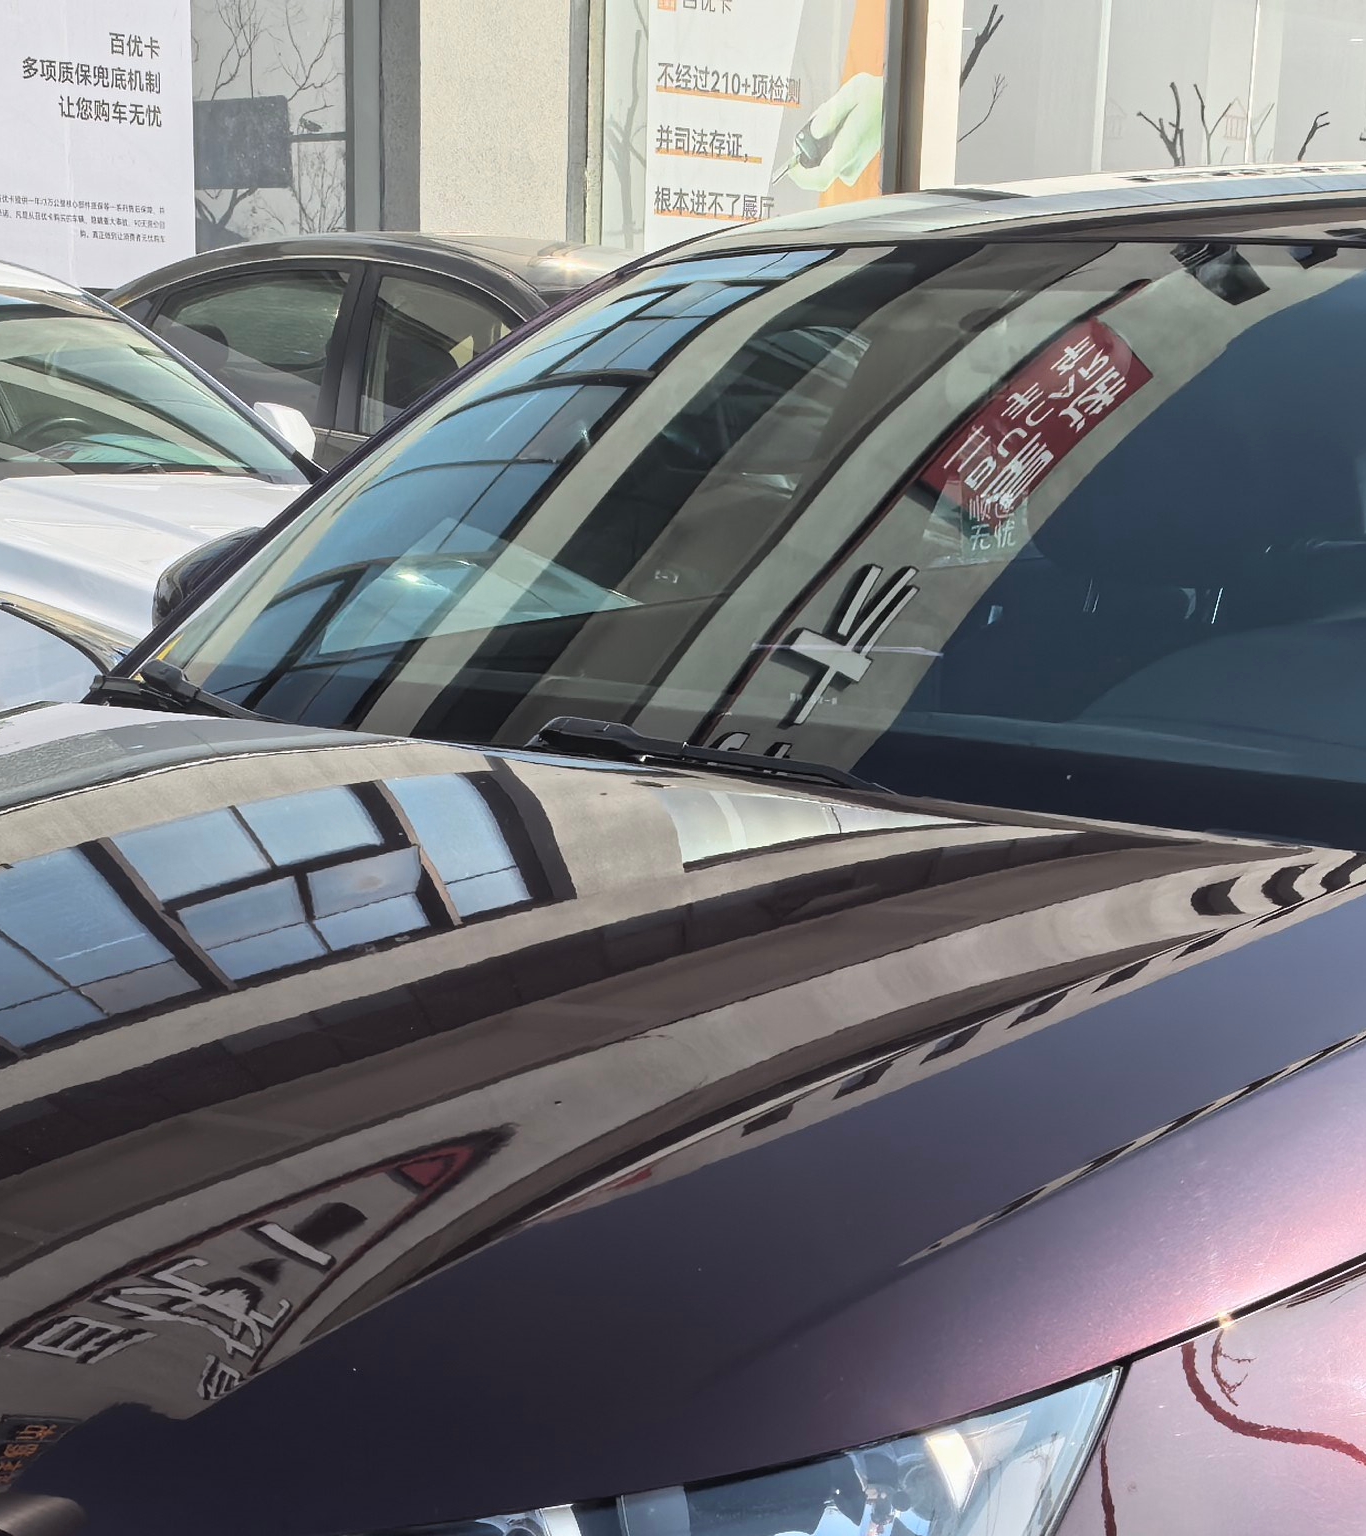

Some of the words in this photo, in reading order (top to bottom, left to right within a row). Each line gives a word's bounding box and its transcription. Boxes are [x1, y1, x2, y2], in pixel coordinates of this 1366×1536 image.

[109, 32, 161, 59] 百优卡
[22, 56, 161, 94] 多项质保兜底机制
[657, 62, 801, 105] 不经过210+项检测
[59, 95, 162, 128] 让您购车无忧
[656, 124, 748, 163] 并司法存证，
[969, 518, 1017, 551] 无忧
